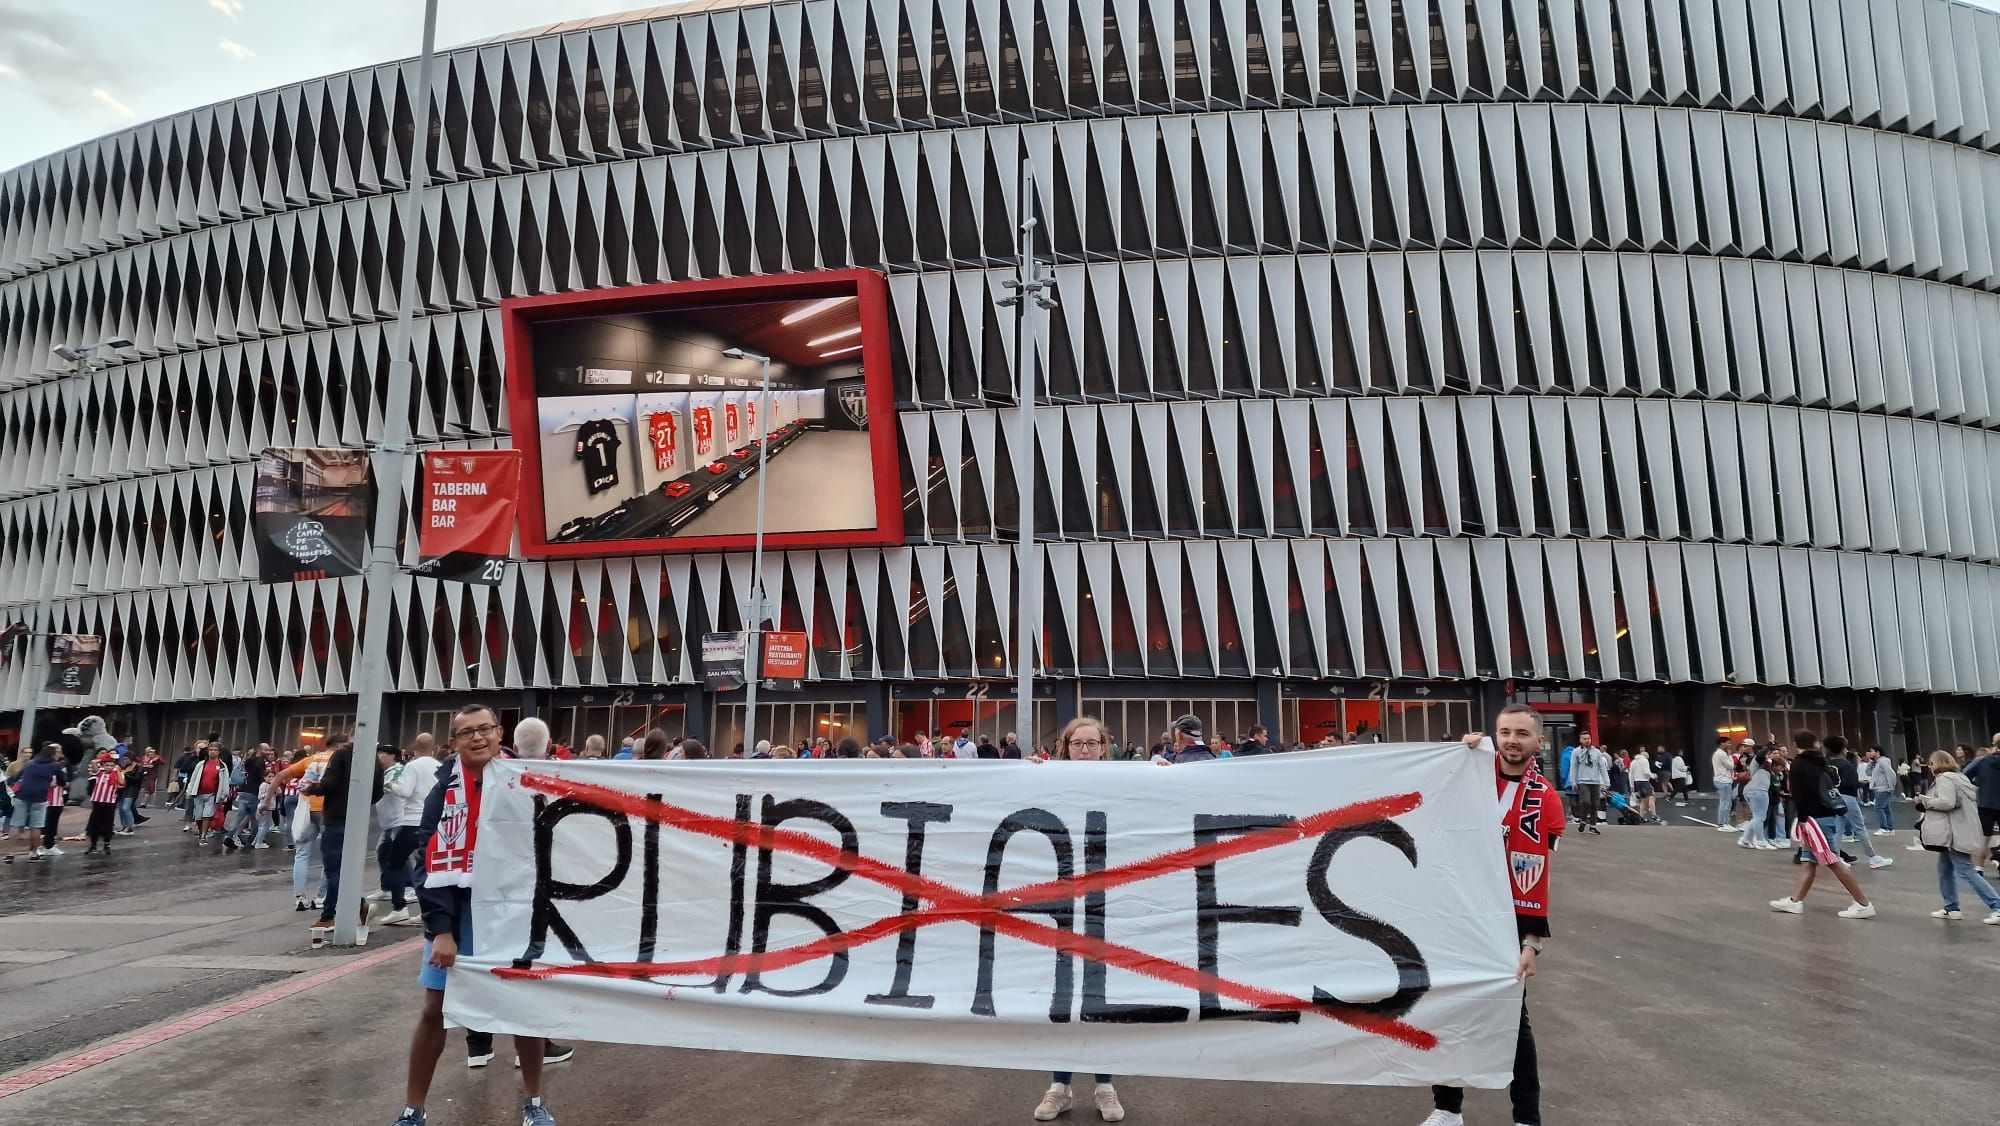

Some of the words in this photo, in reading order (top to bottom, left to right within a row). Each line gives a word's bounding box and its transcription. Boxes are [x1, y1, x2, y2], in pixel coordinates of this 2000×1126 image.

[655, 370, 663, 384] 2
[703, 374, 709, 385] 3
[702, 420, 709, 436] 3
[729, 415, 735, 428] 4
[596, 442, 607, 467] 1
[432, 482, 488, 496] TABERNA
[432, 499, 457, 512] BAR
[297, 522, 308, 530] LA
[431, 515, 456, 528] BAR
[296, 530, 322, 538] CAMPA
[482, 560, 504, 580] 26
[793, 680, 801, 690] 14
[965, 682, 990, 700] 22
[1368, 682, 1390, 701] 21
[613, 689, 634, 706] 23
[1774, 691, 1796, 709] 20
[511, 793, 1431, 1024] RUBIALES
